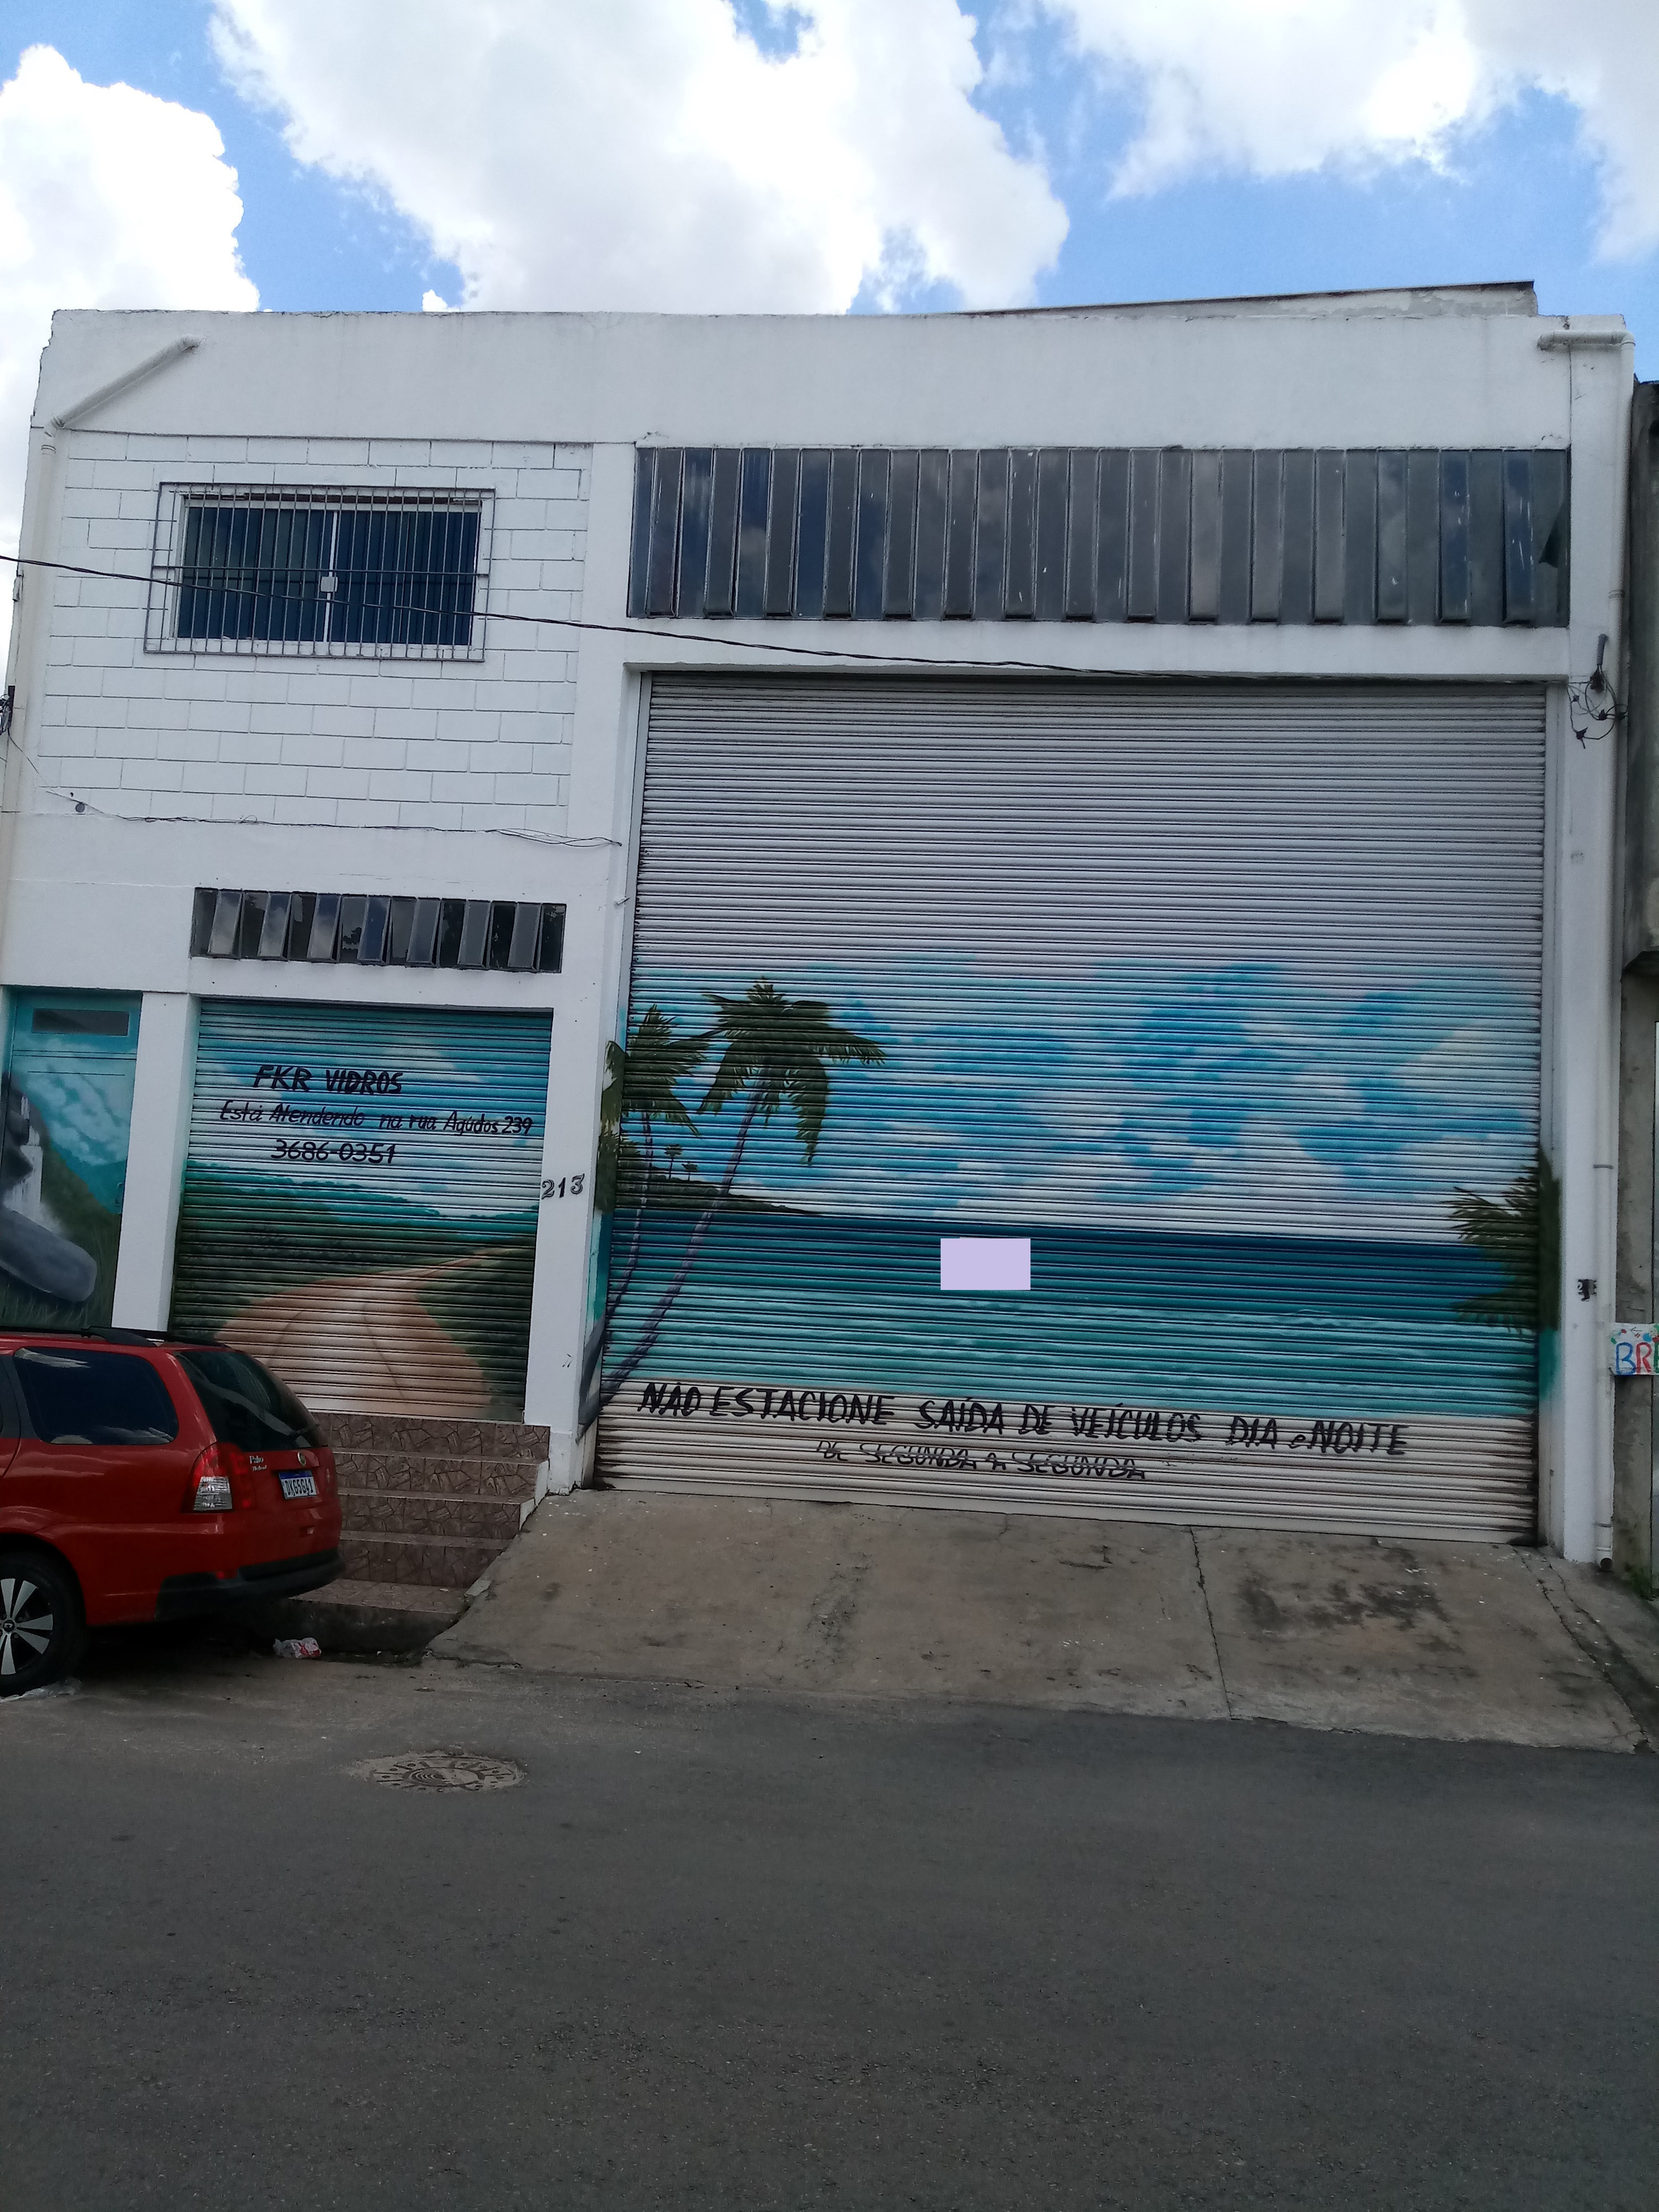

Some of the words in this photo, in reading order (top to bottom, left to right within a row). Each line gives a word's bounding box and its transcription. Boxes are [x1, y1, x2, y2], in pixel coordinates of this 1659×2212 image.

[252, 1064, 312, 1092] FKR
[325, 1069, 404, 1095] VIDROS
[268, 1103, 365, 1127] Atendendo
[379, 1114, 403, 1130] na
[409, 1115, 438, 1131] rua
[501, 1116, 533, 1135] 239
[271, 1139, 396, 1164] 3686-0351
[541, 1173, 585, 1200] 213
[1615, 1342, 1659, 1376] BR
[709, 1387, 894, 1426] ESTACIONE
[1019, 1404, 1055, 1435] DE
[1225, 1415, 1277, 1450] DIA
[1307, 1420, 1409, 1456] NOITE
[816, 1440, 849, 1463] DE
[859, 1442, 977, 1470] SEGUNDA
[985, 1452, 1007, 1471] A
[1012, 1451, 1146, 1480] SEGUNDA
